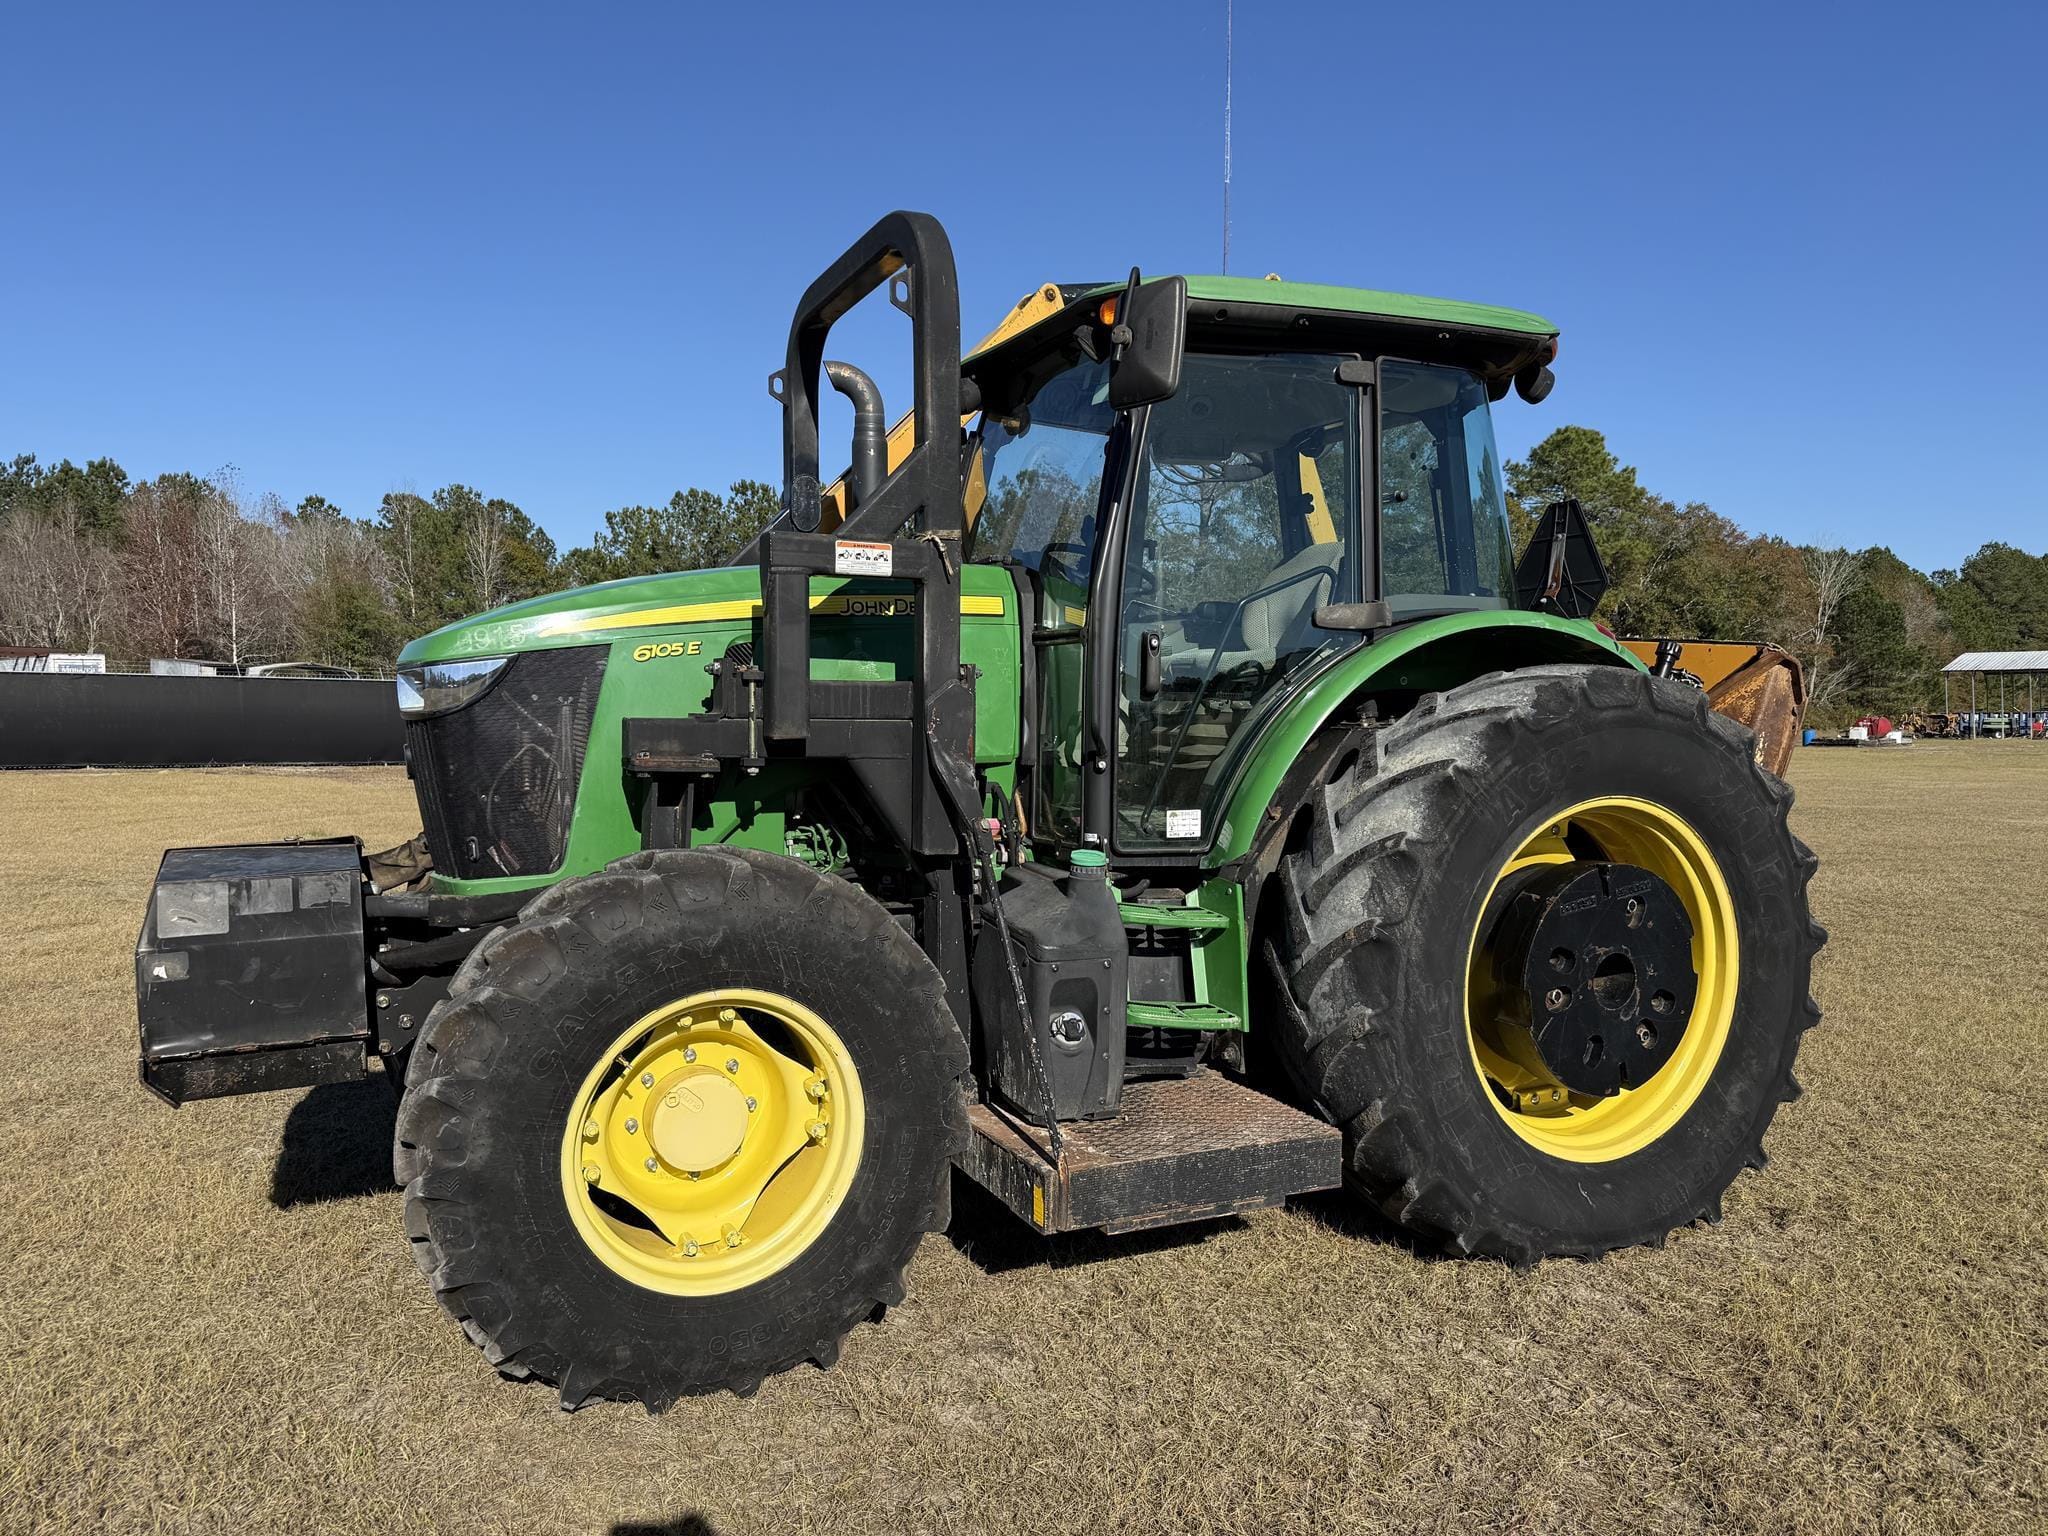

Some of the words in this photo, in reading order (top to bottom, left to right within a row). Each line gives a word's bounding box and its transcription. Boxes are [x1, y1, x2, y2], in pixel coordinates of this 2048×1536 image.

[840, 598, 891, 614] JOHN
[633, 641, 685, 662] 6105
[687, 640, 702, 656] E
[528, 927, 727, 1080] GALAXY
[708, 1322, 772, 1355] 850
